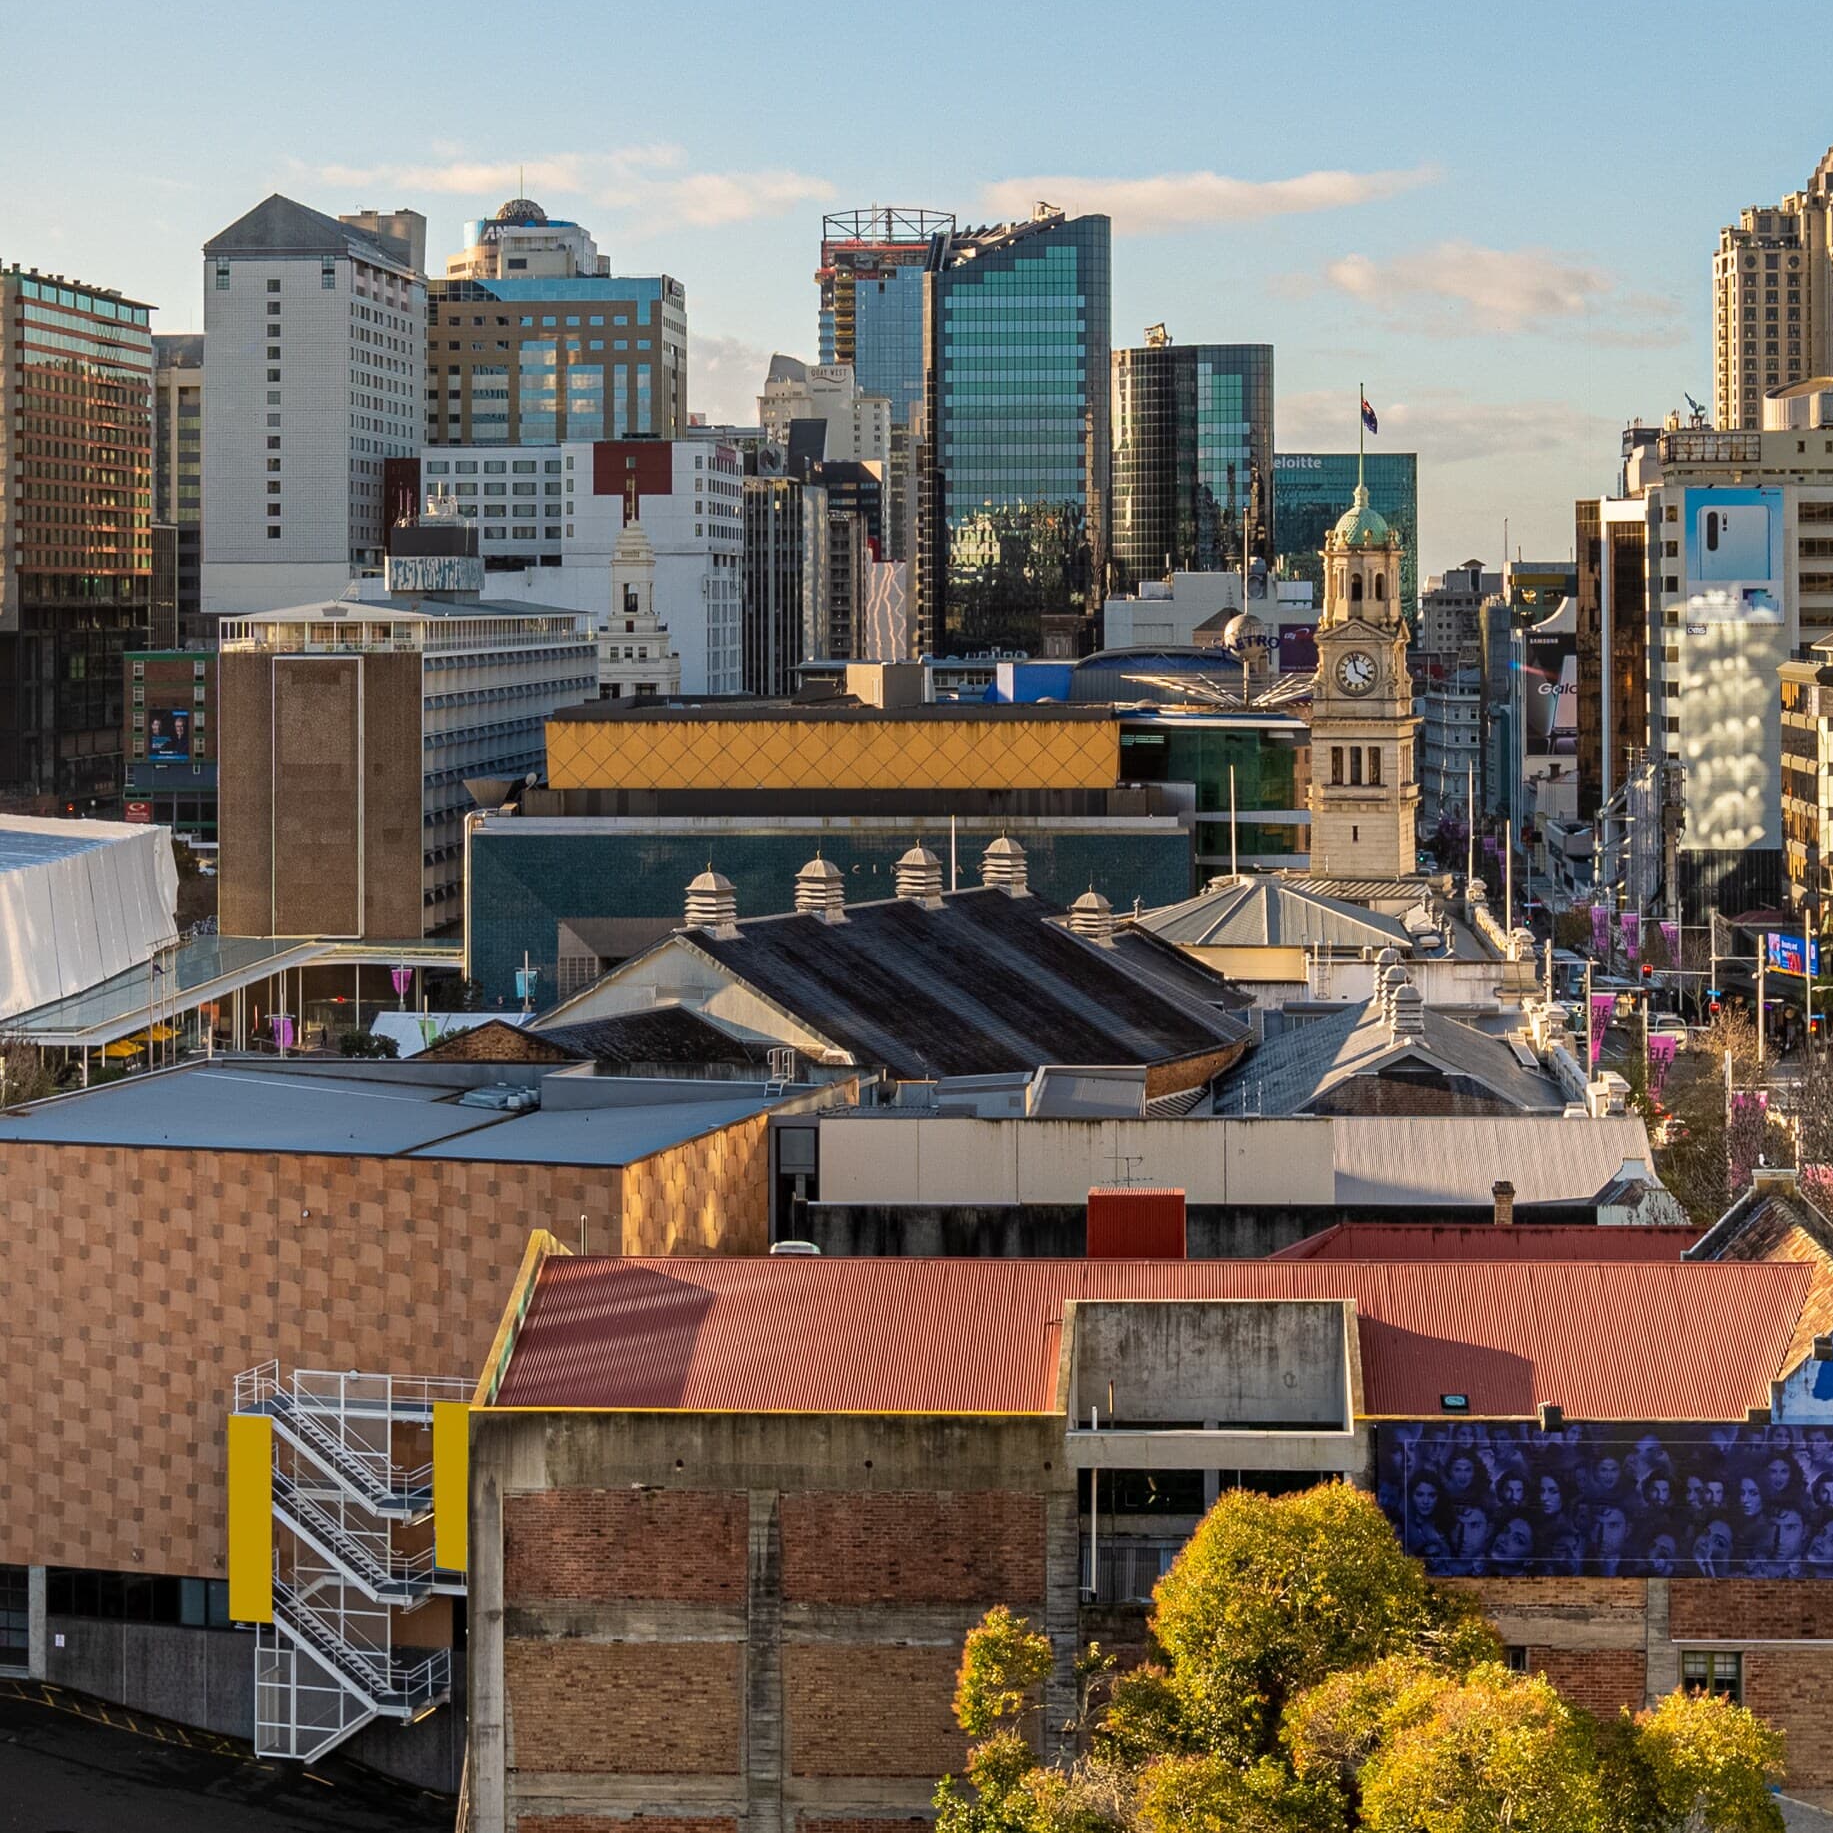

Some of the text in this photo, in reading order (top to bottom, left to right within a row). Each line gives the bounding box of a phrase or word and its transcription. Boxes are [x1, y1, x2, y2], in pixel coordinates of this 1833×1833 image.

[483, 225, 508, 240] AN
[1273, 455, 1322, 469] eloitte
[1537, 682, 1578, 696] Gala
